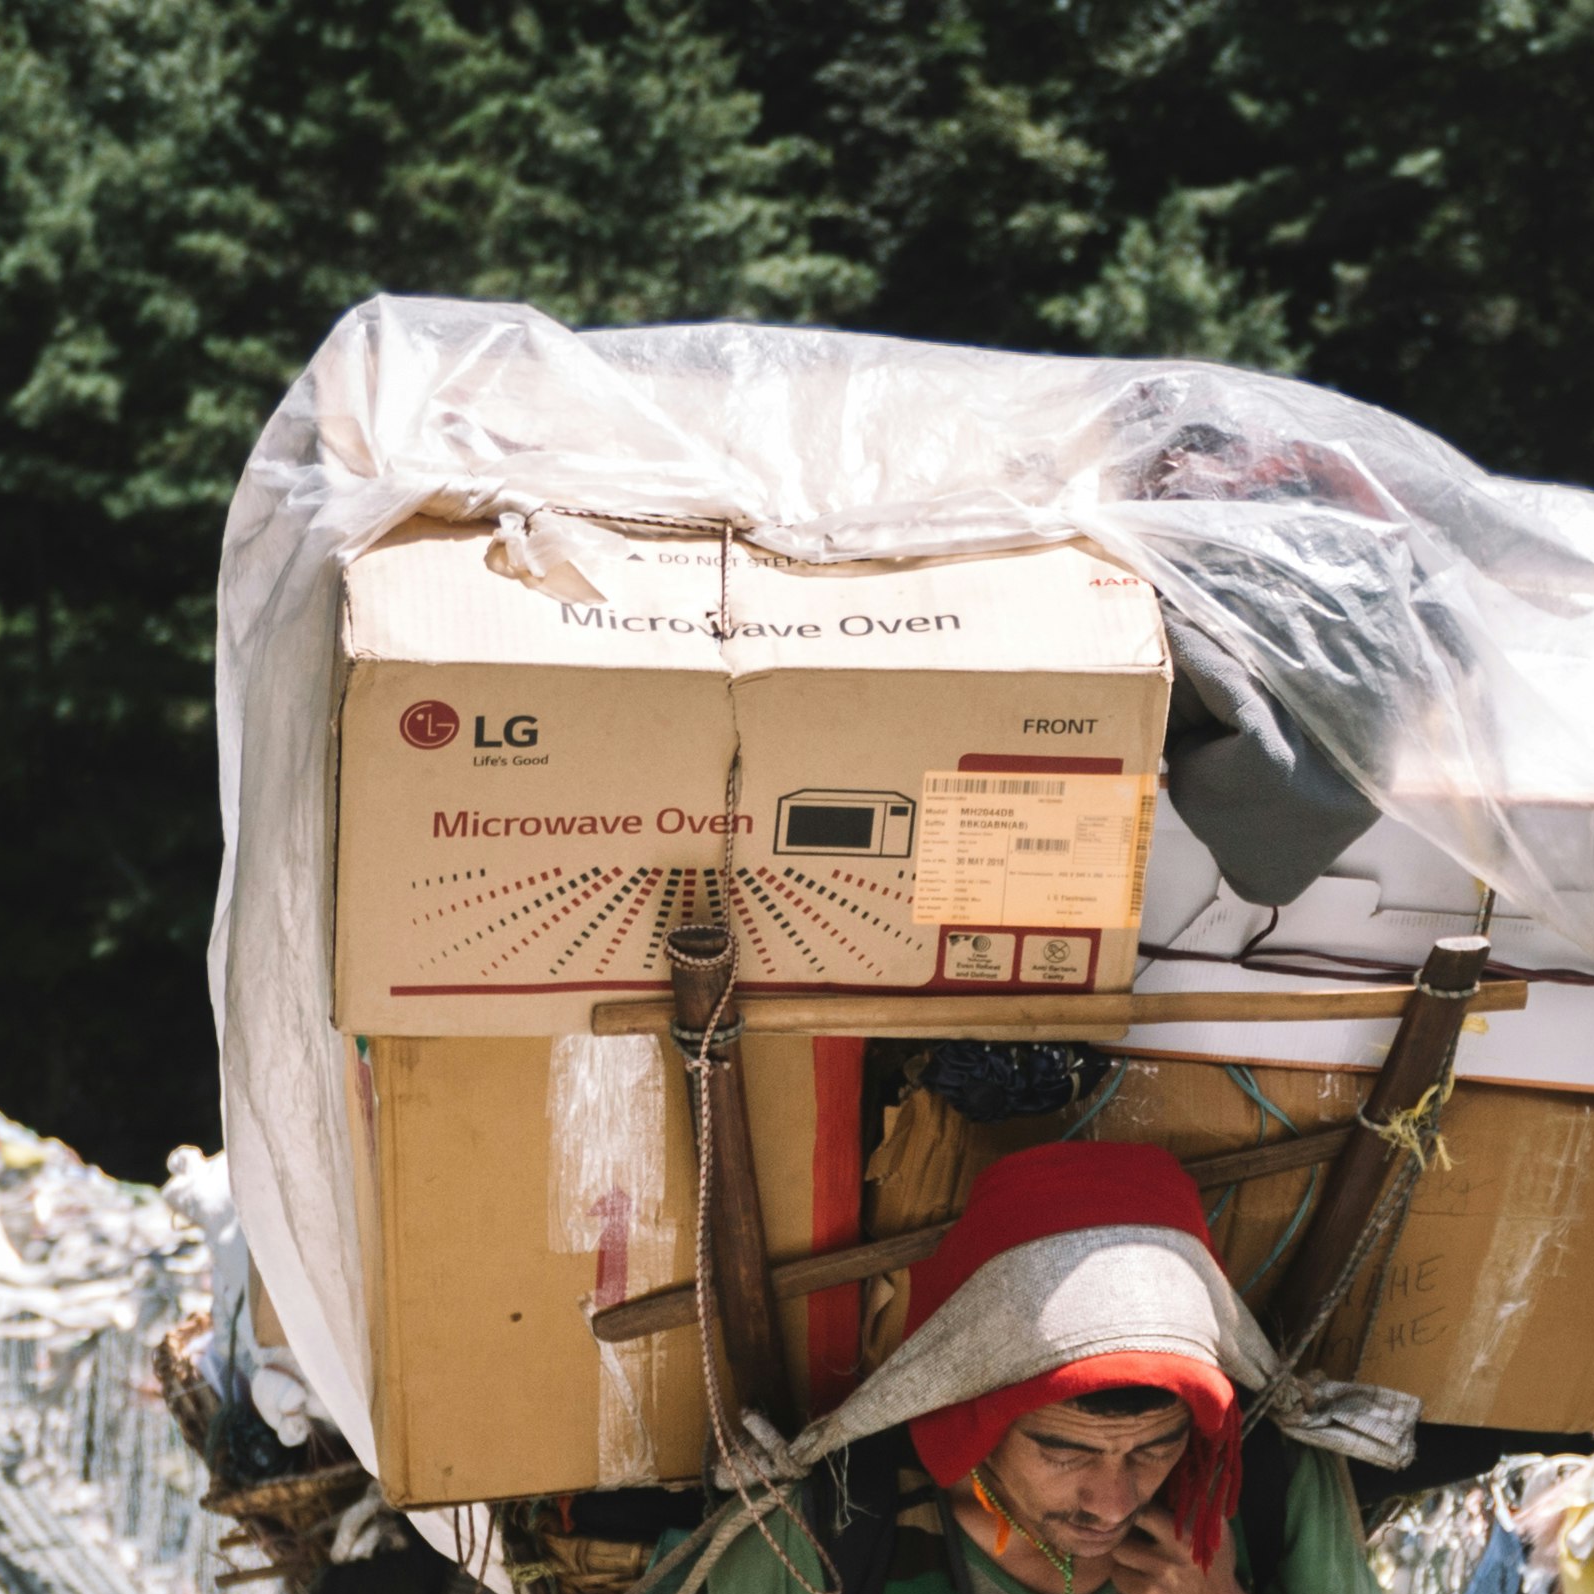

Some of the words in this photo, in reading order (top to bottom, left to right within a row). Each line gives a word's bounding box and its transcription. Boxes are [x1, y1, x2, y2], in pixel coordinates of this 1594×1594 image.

[659, 552, 690, 566] DO
[697, 554, 740, 568] NOT
[560, 601, 823, 640] Microwave
[838, 611, 962, 638] Oven
[473, 714, 539, 748] LG
[1023, 718, 1099, 735] FRONT
[473, 755, 508, 768] Life's
[512, 754, 549, 767] Good
[432, 810, 643, 839] Microwave
[656, 807, 754, 835] Oven
[968, 856, 985, 867] MAY
[956, 971, 969, 979] and
